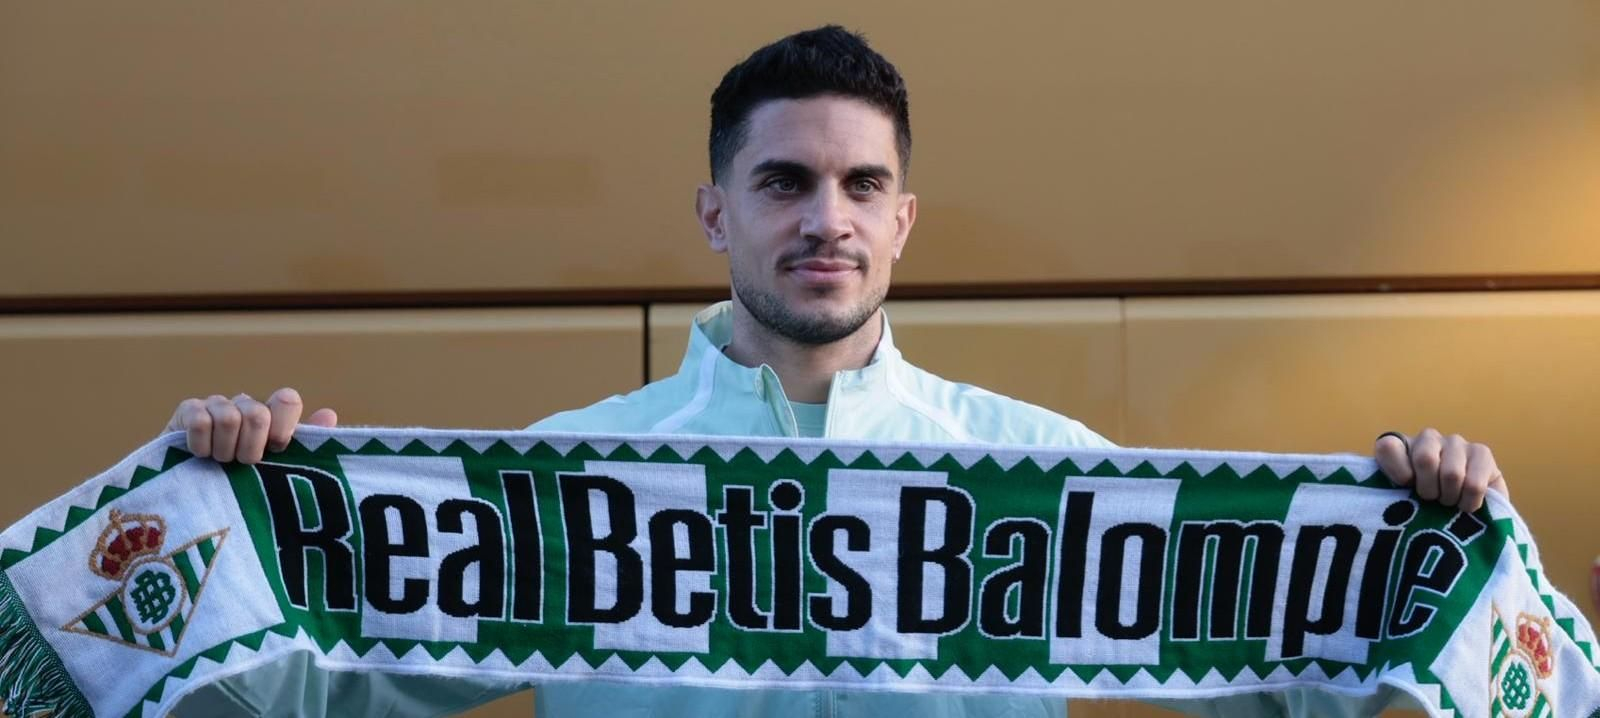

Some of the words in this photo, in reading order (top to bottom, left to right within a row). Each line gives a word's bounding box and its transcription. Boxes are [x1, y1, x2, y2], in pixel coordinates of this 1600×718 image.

[258, 462, 543, 622] Real
[557, 472, 872, 632] Betis
[897, 485, 1486, 659] Balompié
